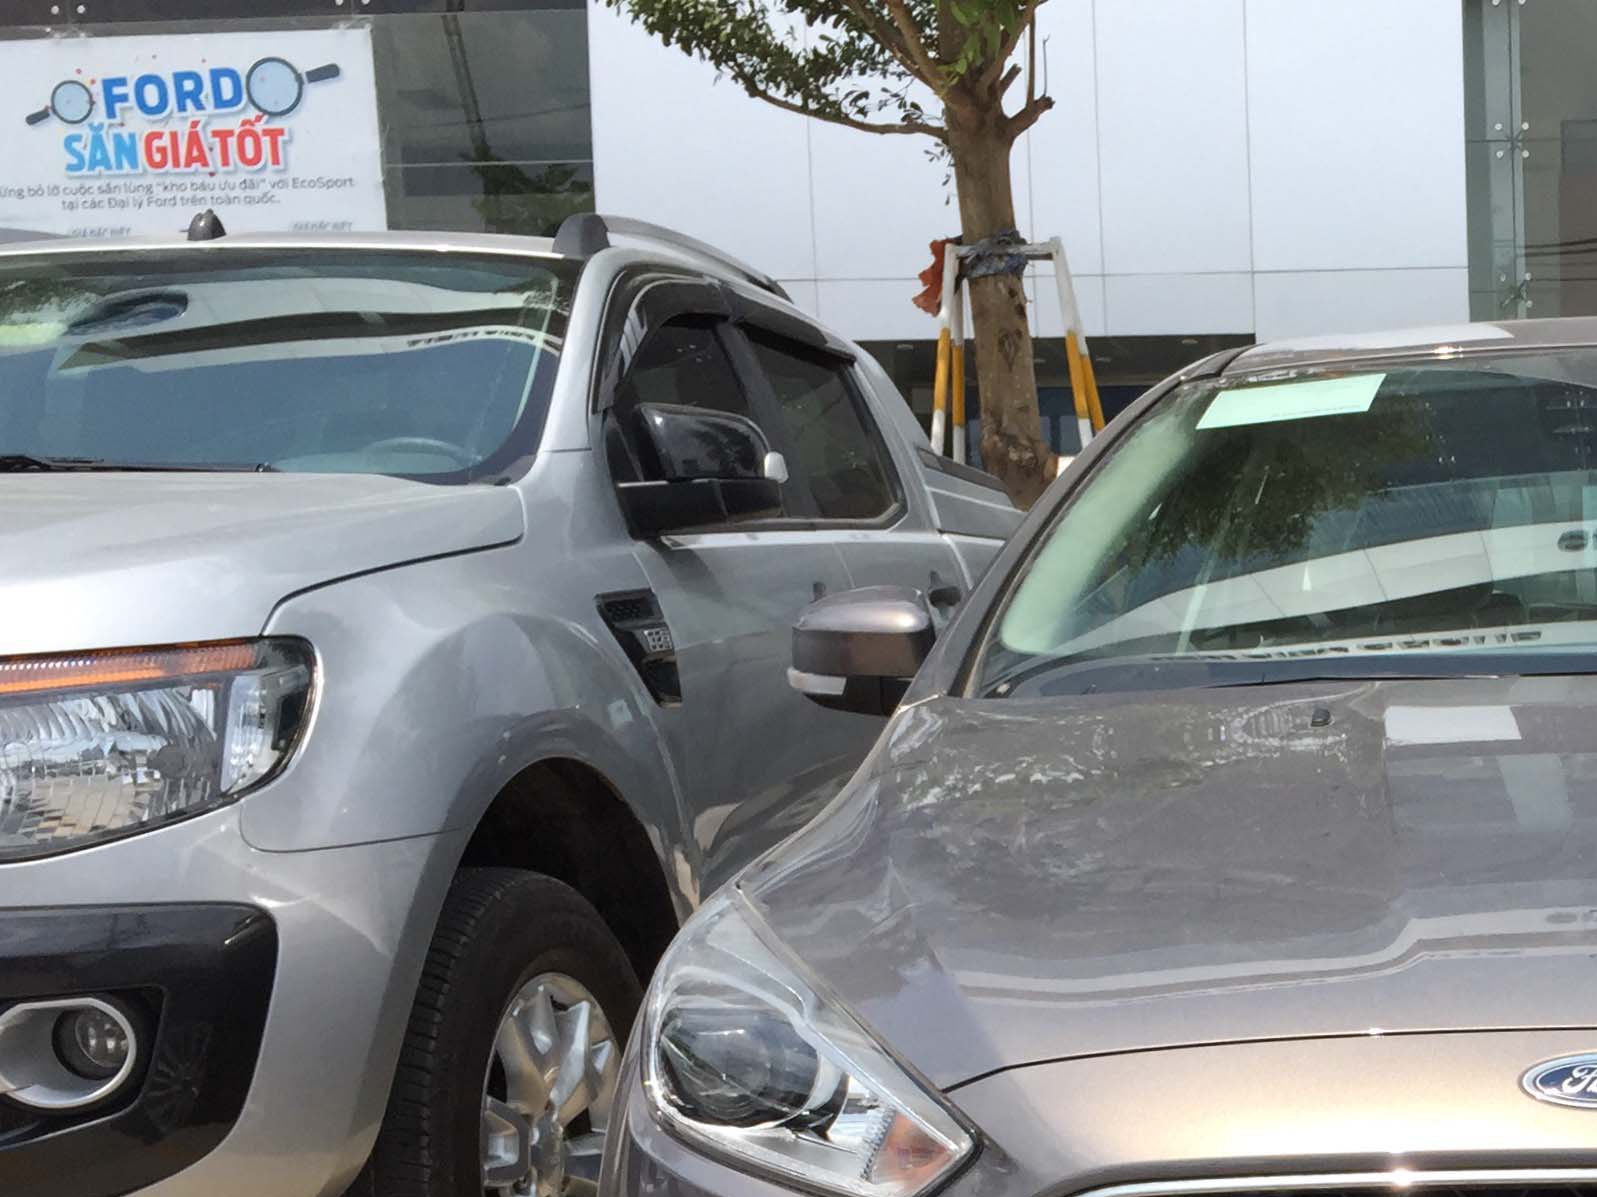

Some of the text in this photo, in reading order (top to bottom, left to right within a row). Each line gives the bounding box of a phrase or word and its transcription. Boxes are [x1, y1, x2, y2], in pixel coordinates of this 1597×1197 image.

[102, 67, 243, 119] FORD
[63, 113, 285, 173] SĂN GIÁ TỐT
[291, 176, 354, 191] EcoSport
[146, 195, 178, 208] Ford
